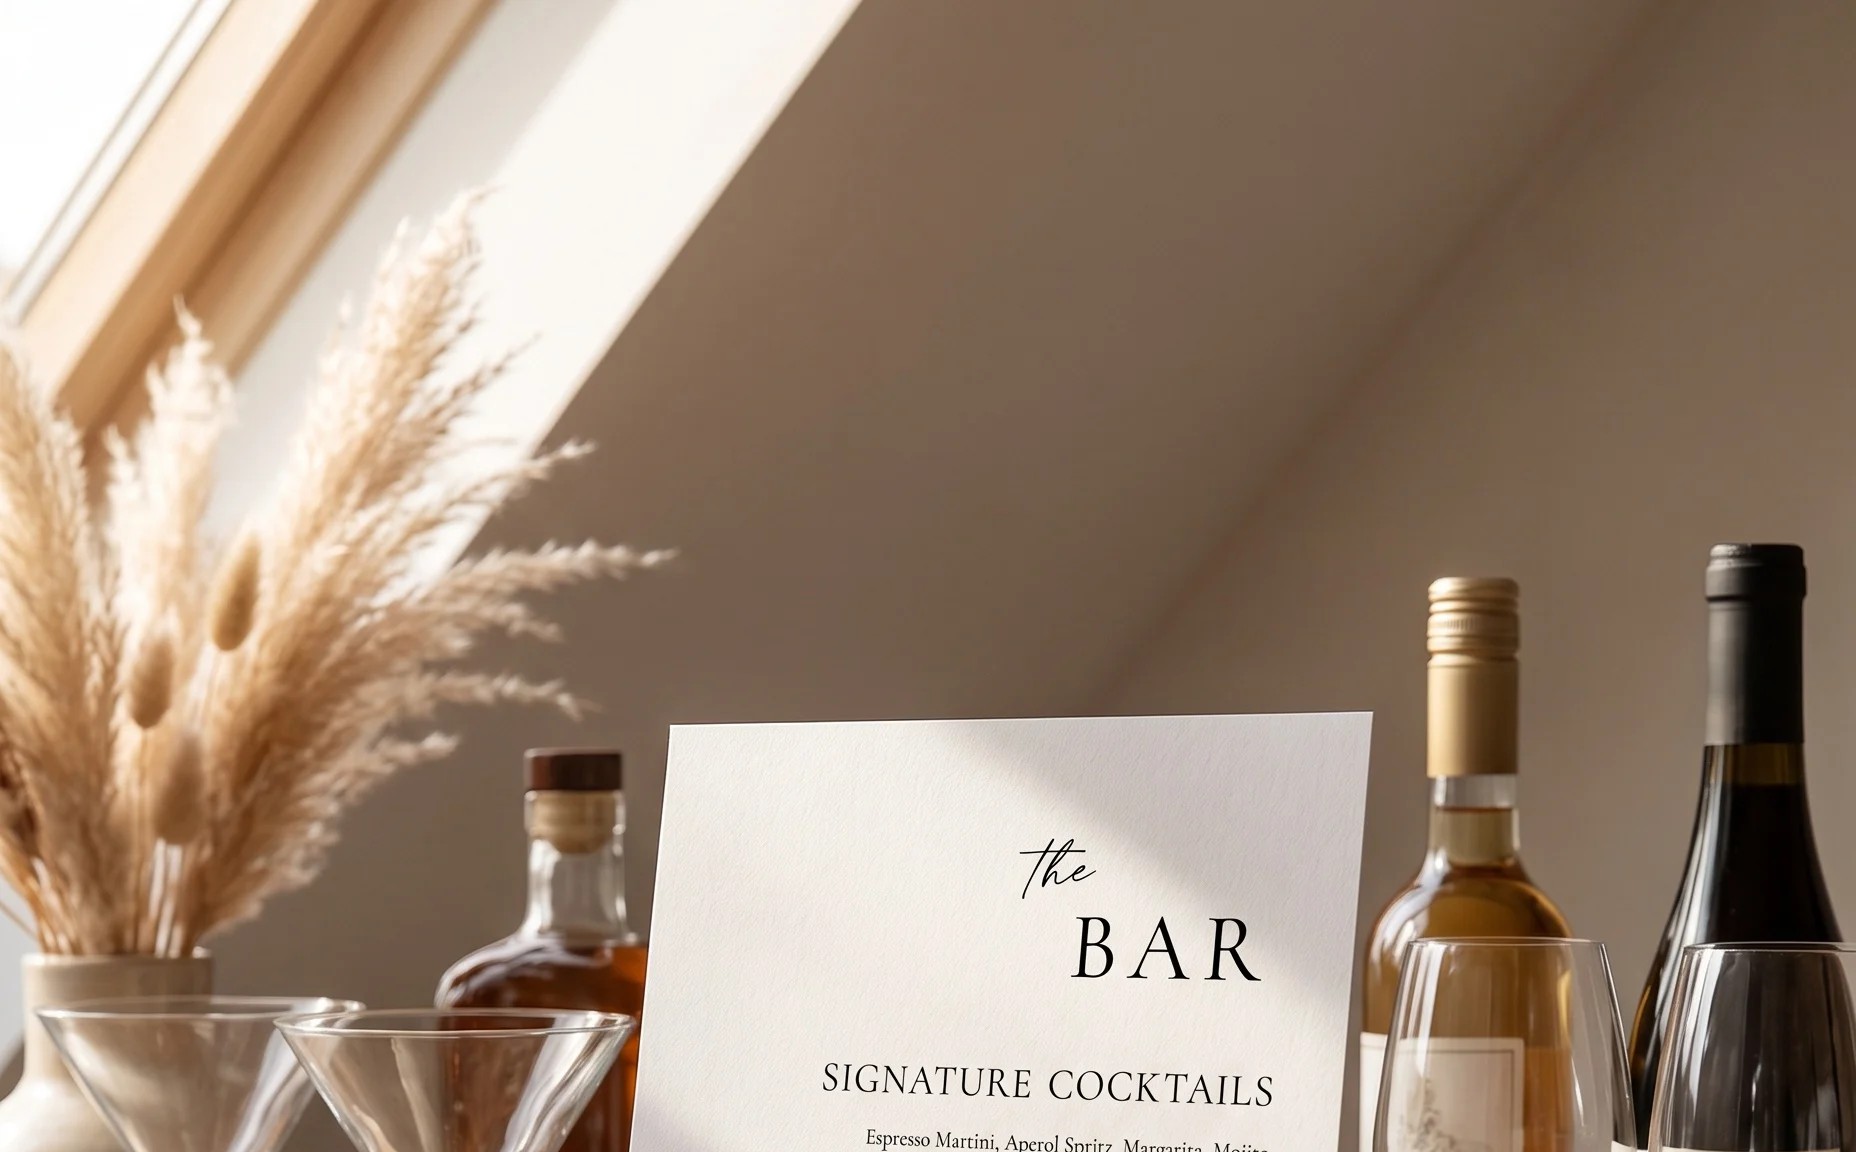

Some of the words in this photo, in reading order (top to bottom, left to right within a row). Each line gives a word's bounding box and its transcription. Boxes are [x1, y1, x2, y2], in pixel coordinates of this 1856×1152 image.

[1018, 837, 1097, 900] the
[1070, 915, 1262, 982] BAR
[822, 1062, 1031, 1099] SIGNATURE
[1048, 1069, 1273, 1107] COCKTAILS
[865, 1128, 931, 1152] Espresso
